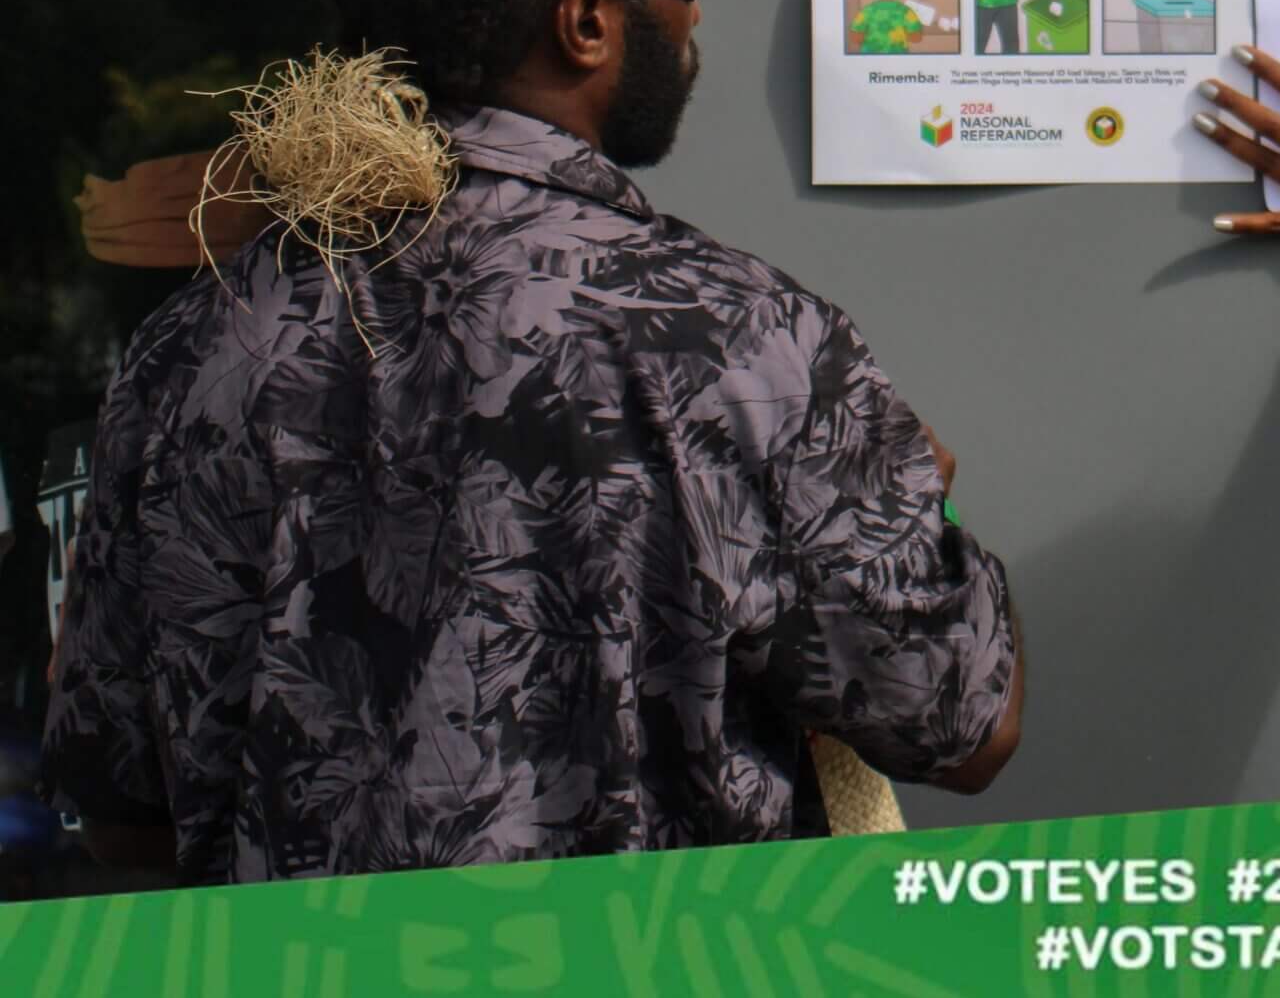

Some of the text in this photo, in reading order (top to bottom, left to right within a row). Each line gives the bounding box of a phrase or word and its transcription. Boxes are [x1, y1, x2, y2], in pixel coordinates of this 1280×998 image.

[868, 71, 939, 84] Rimemba:
[960, 103, 993, 114] 2024
[960, 116, 1032, 128] NASONAL
[960, 129, 1062, 142] REFERANDOM
